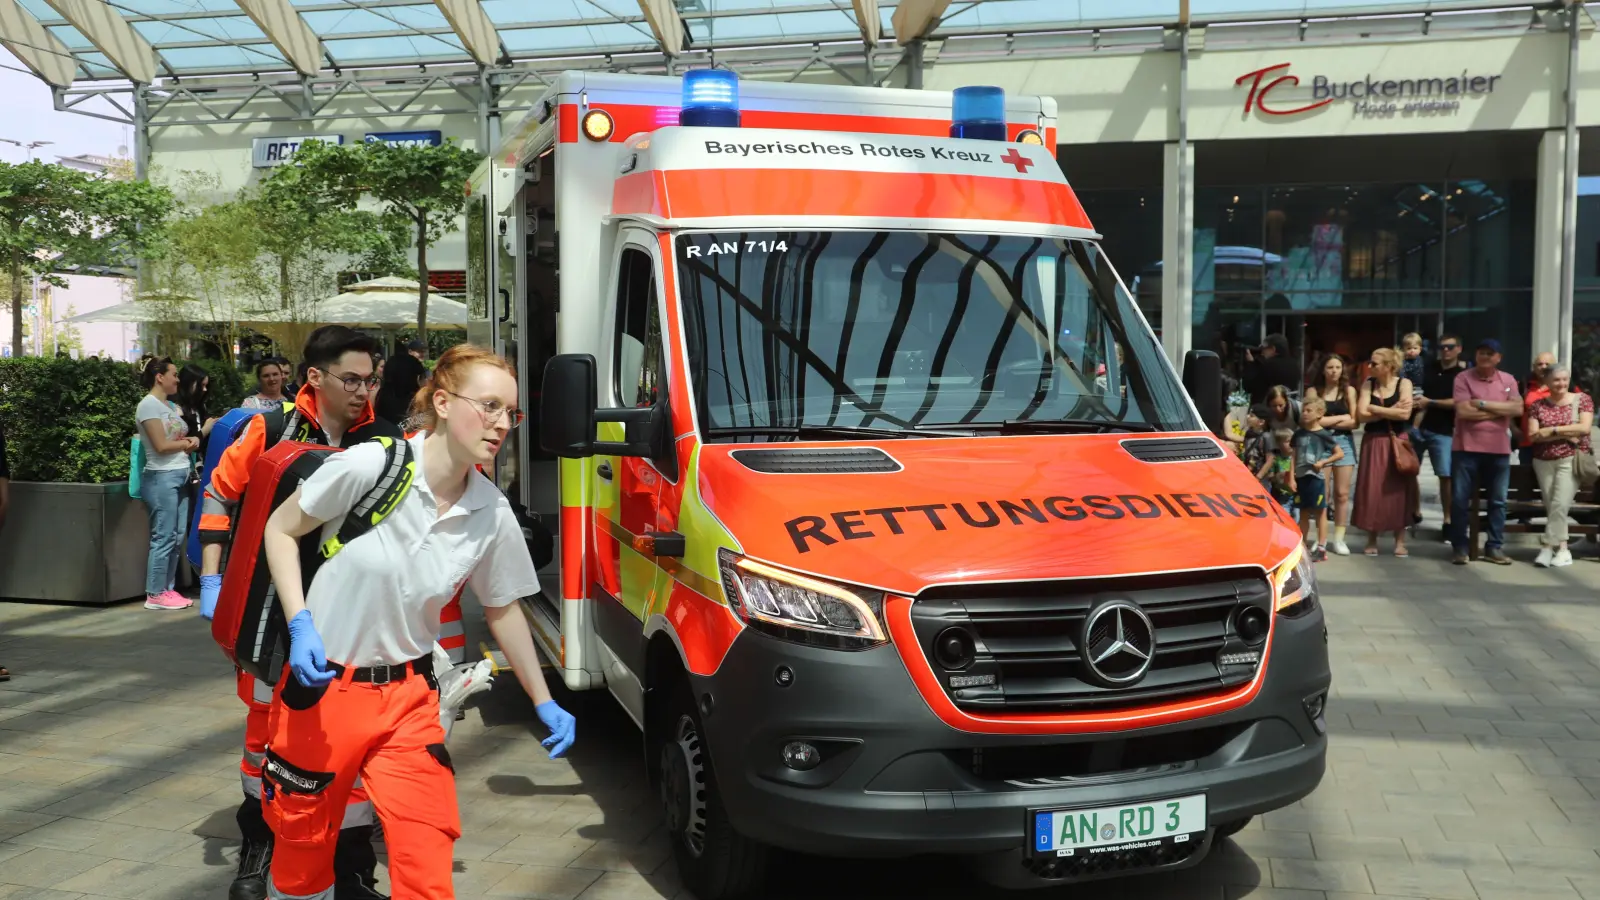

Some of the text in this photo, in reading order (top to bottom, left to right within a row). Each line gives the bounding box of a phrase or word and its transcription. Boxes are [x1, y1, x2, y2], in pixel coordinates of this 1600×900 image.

[1311, 68, 1502, 100] Buckenmaier
[704, 140, 993, 164] Bayerisches Rotes Kreuz
[686, 240, 789, 259] R AN 71/4
[784, 493, 1285, 554] RETTUNGSDIENST
[1059, 801, 1180, 845] AN RD 3
[1040, 835, 1048, 844] D
[1089, 839, 1162, 854] www.was-vehicles.com
